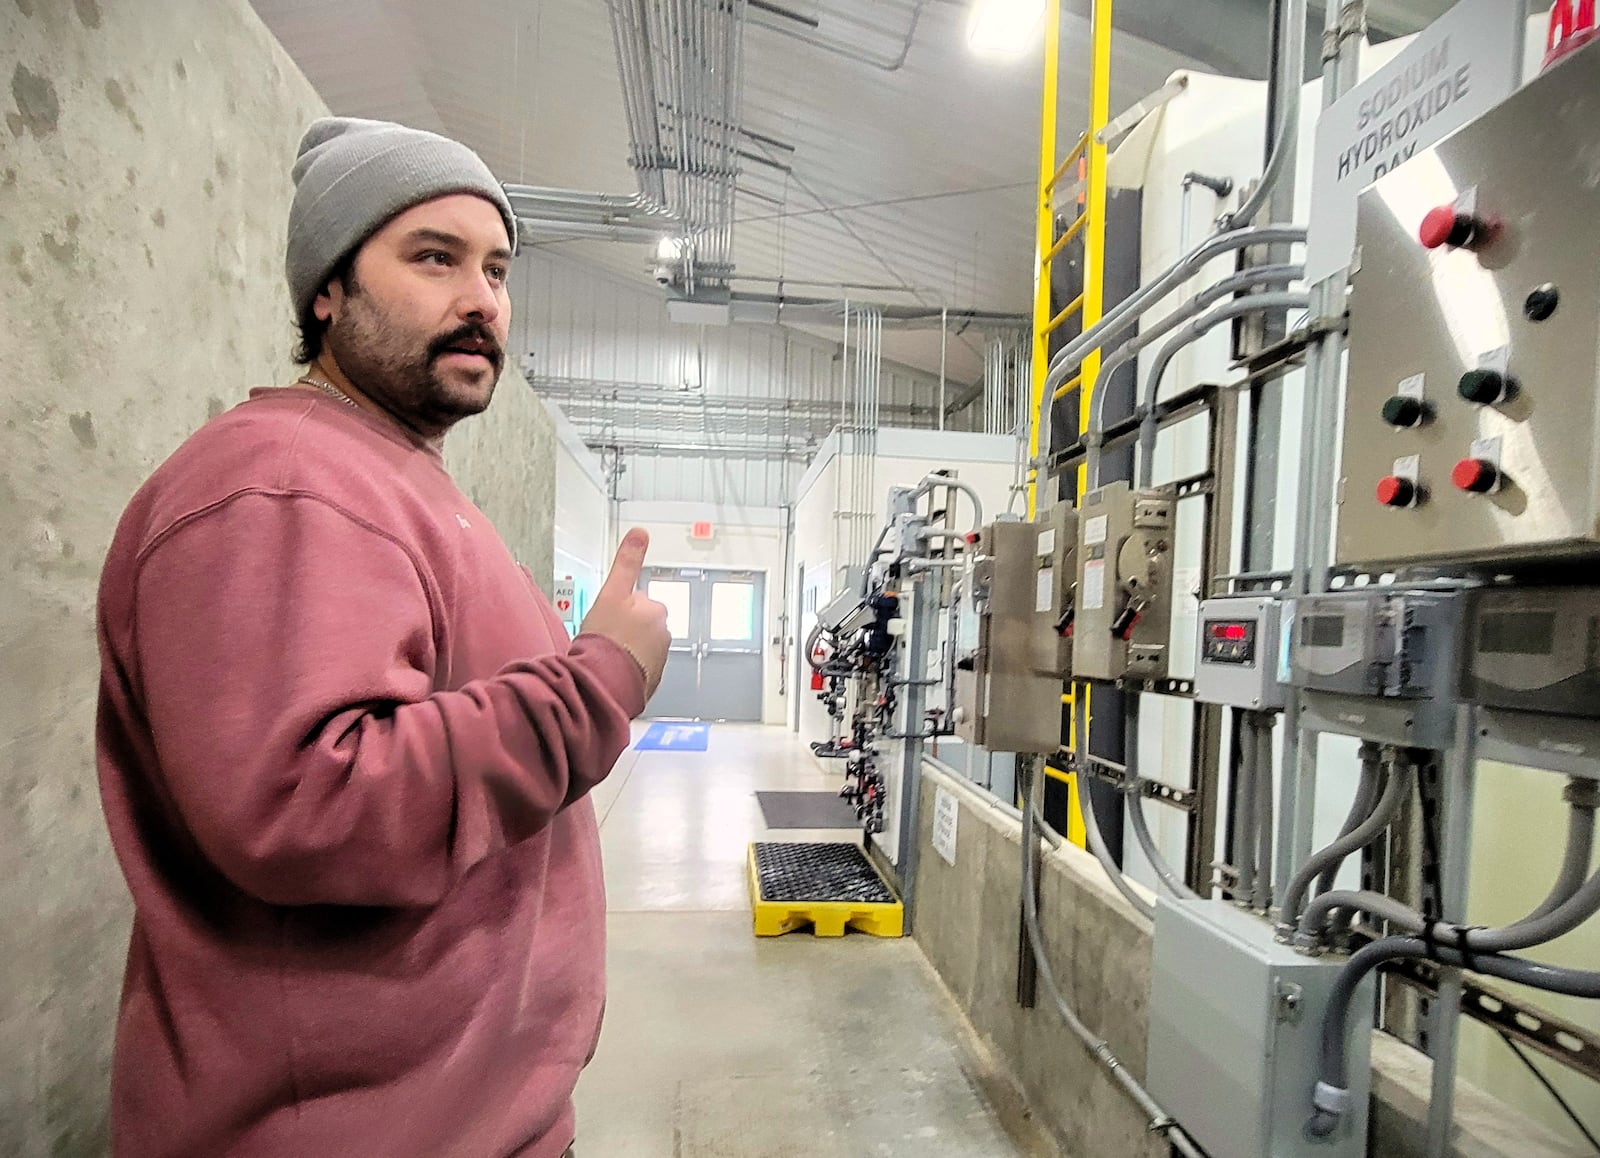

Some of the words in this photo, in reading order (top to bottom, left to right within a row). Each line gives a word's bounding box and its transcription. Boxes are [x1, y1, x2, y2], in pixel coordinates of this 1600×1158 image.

[1337, 61, 1472, 182] HYDROXIDE
[1357, 34, 1451, 131] SODIUM
[556, 588, 574, 596] AED
